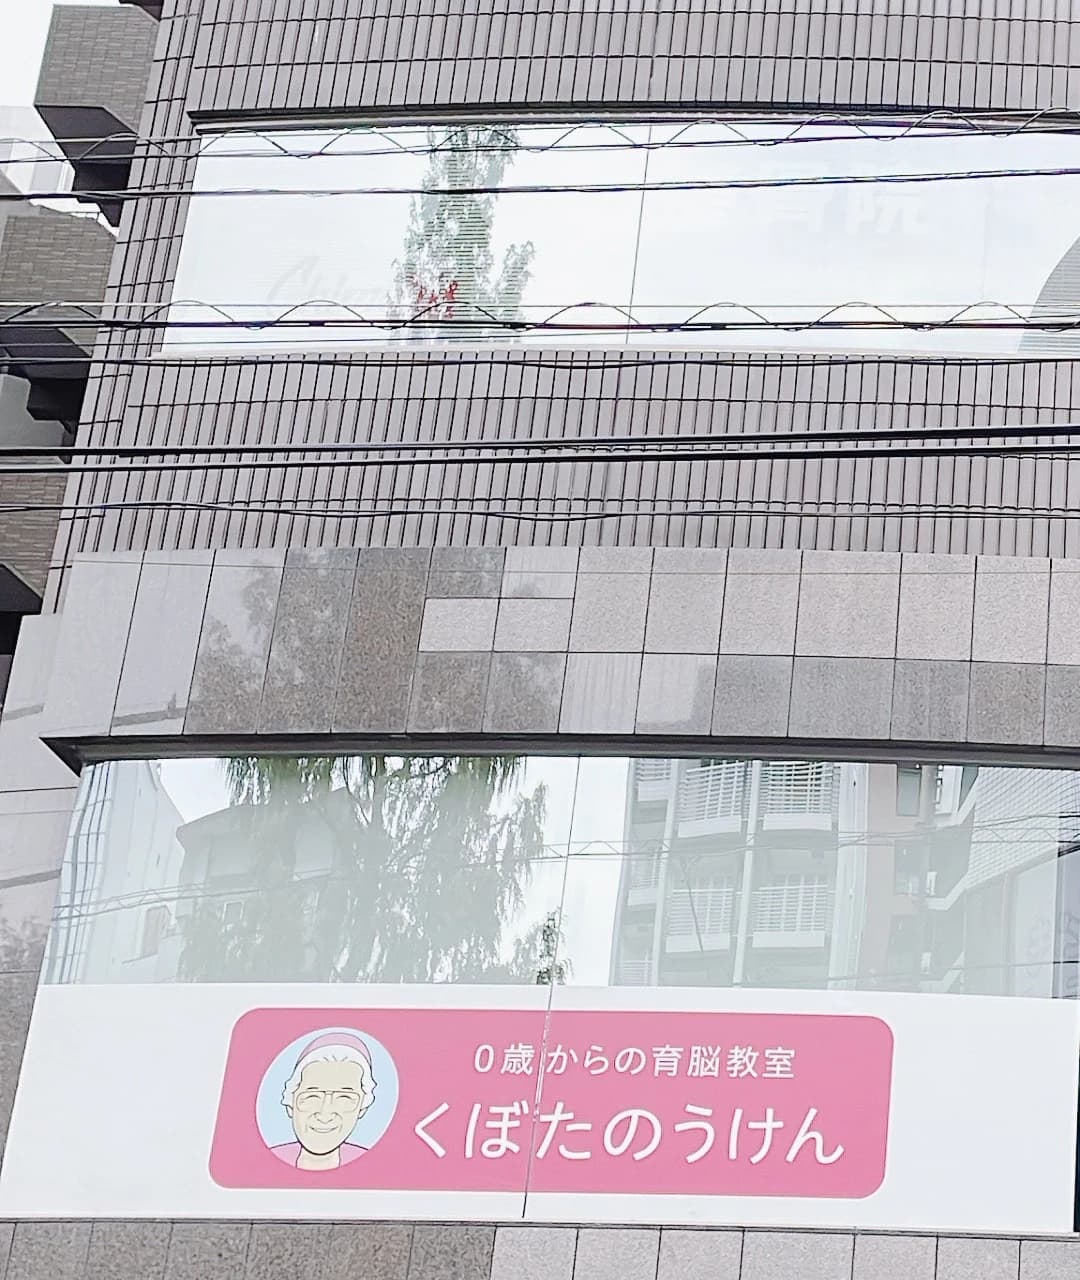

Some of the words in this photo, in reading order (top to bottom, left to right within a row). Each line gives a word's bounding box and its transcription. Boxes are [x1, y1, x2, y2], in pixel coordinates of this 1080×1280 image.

[473, 1042, 797, 1080] 0歳からの育脳教室
[413, 1099, 845, 1166] くぼたのうけん
